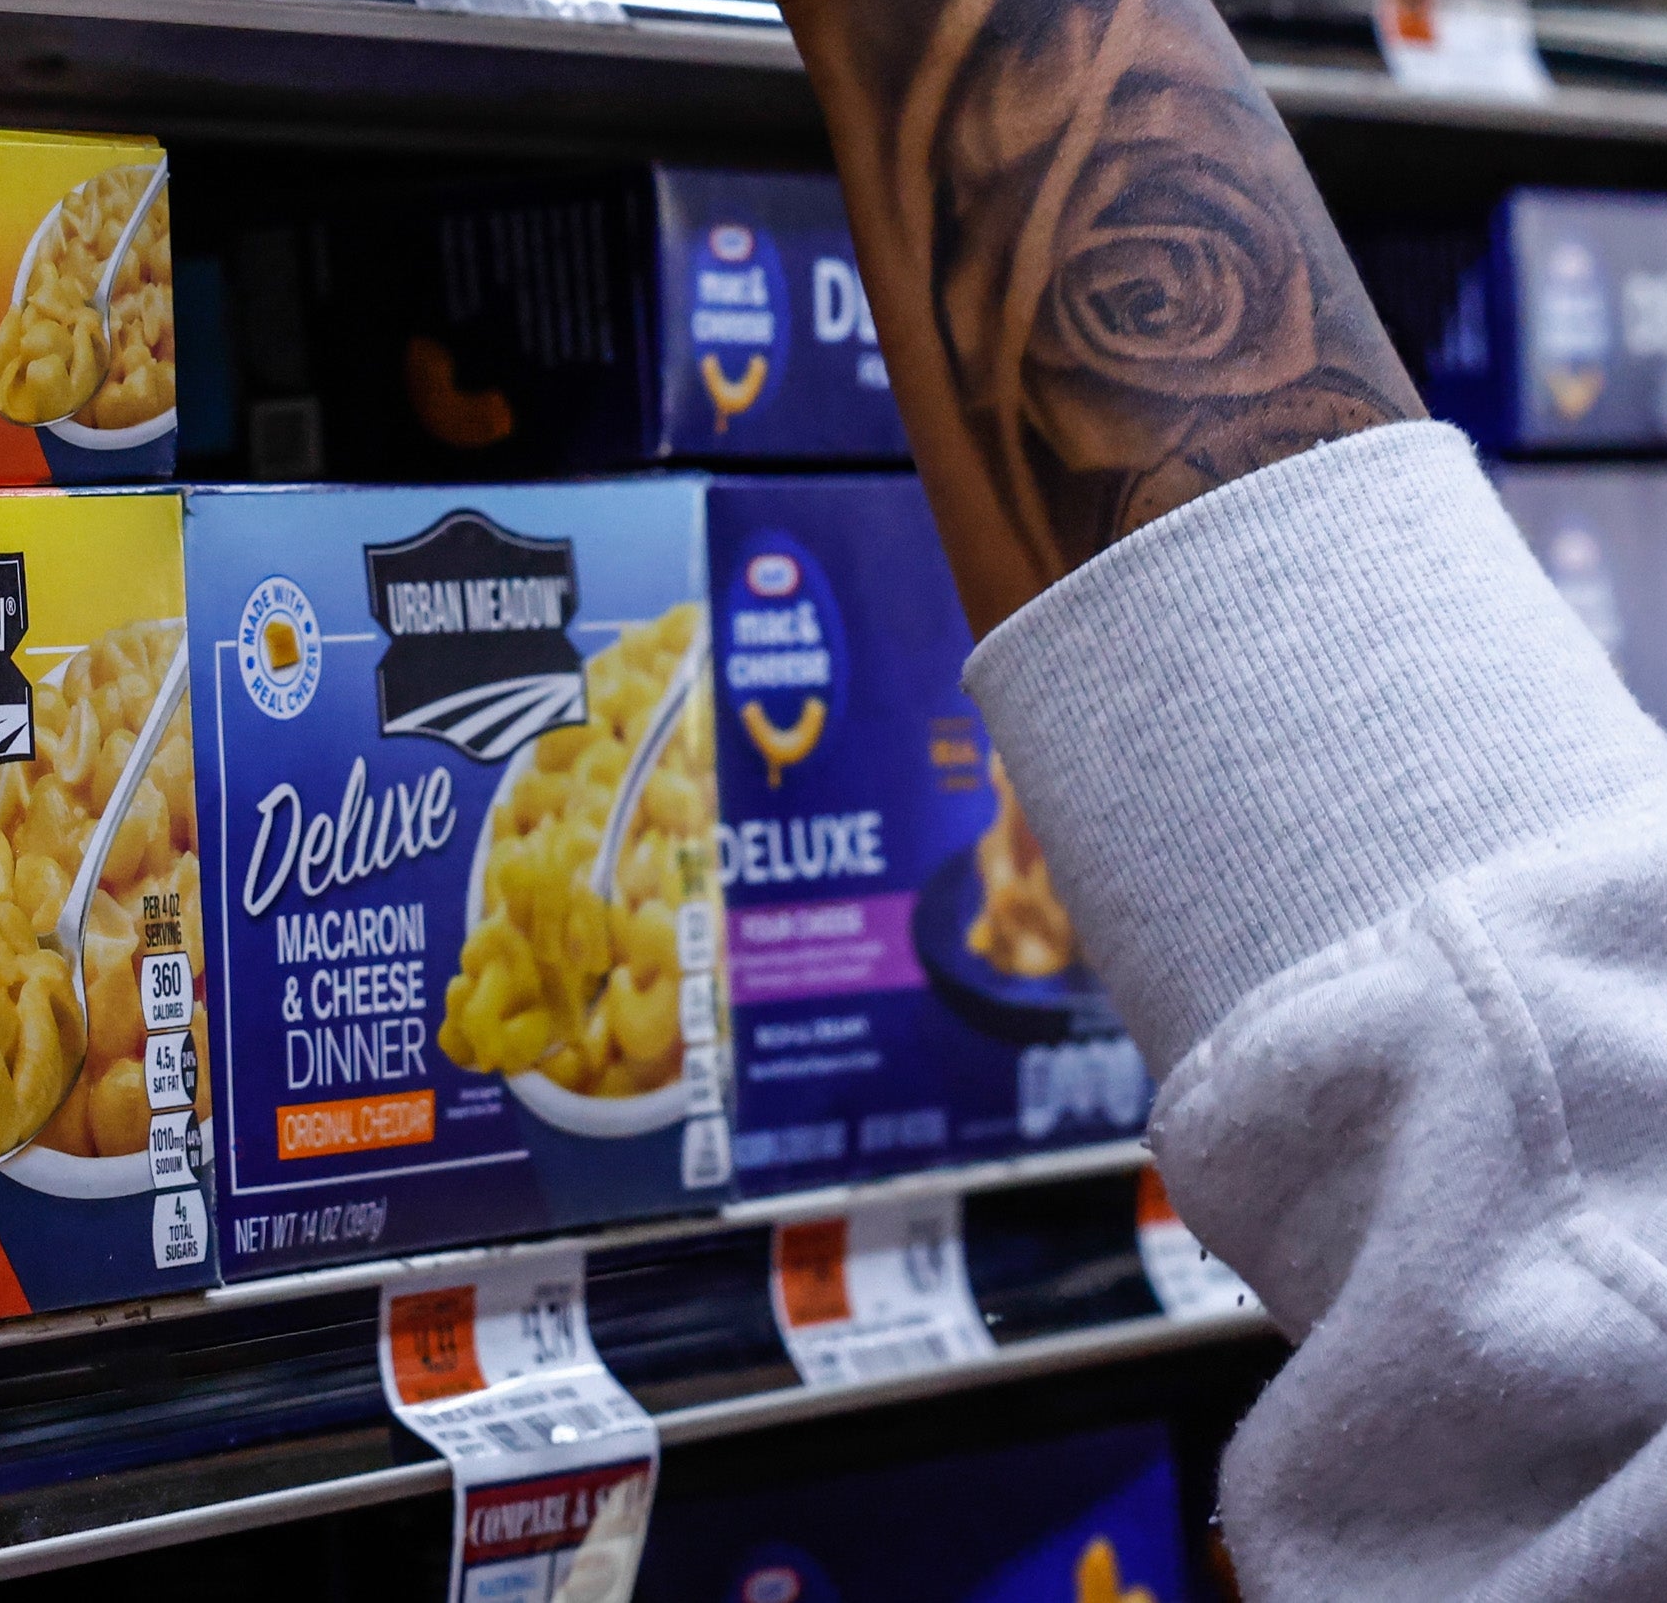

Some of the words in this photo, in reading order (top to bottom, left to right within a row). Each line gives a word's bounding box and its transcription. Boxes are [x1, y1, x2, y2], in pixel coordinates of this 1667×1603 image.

[243, 589, 271, 645] MADE
[387, 581, 464, 635] URBAN
[251, 675, 283, 713] REAL
[243, 755, 457, 917] Deluxe
[712, 810, 887, 888] DELUXE
[143, 896, 161, 920] PER
[162, 894, 168, 917] 4
[169, 893, 181, 917] OZ
[144, 920, 182, 948] SERVING
[276, 902, 426, 964] MACARONI
[152, 961, 181, 999] 360
[282, 975, 303, 1023] &
[311, 960, 427, 1020] CHEESE
[153, 1002, 184, 1021] CALORIES
[156, 1046, 176, 1073] 4.5g
[286, 1017, 427, 1090] DINNER
[153, 1077, 166, 1094] SAT
[167, 1074, 180, 1092] FAT
[152, 1127, 185, 1153] 1010mg
[284, 1105, 357, 1151] ORIGINAL
[360, 1099, 430, 1142] CHEDDAR
[155, 1158, 183, 1176] SODIUM
[175, 1196, 187, 1222] 4g
[169, 1224, 194, 1241] TOTAL
[234, 1216, 270, 1254] NET
[272, 1212, 299, 1248] WT
[301, 1209, 317, 1243] 14
[319, 1206, 342, 1242] OZ
[165, 1241, 199, 1262] SUGARS
